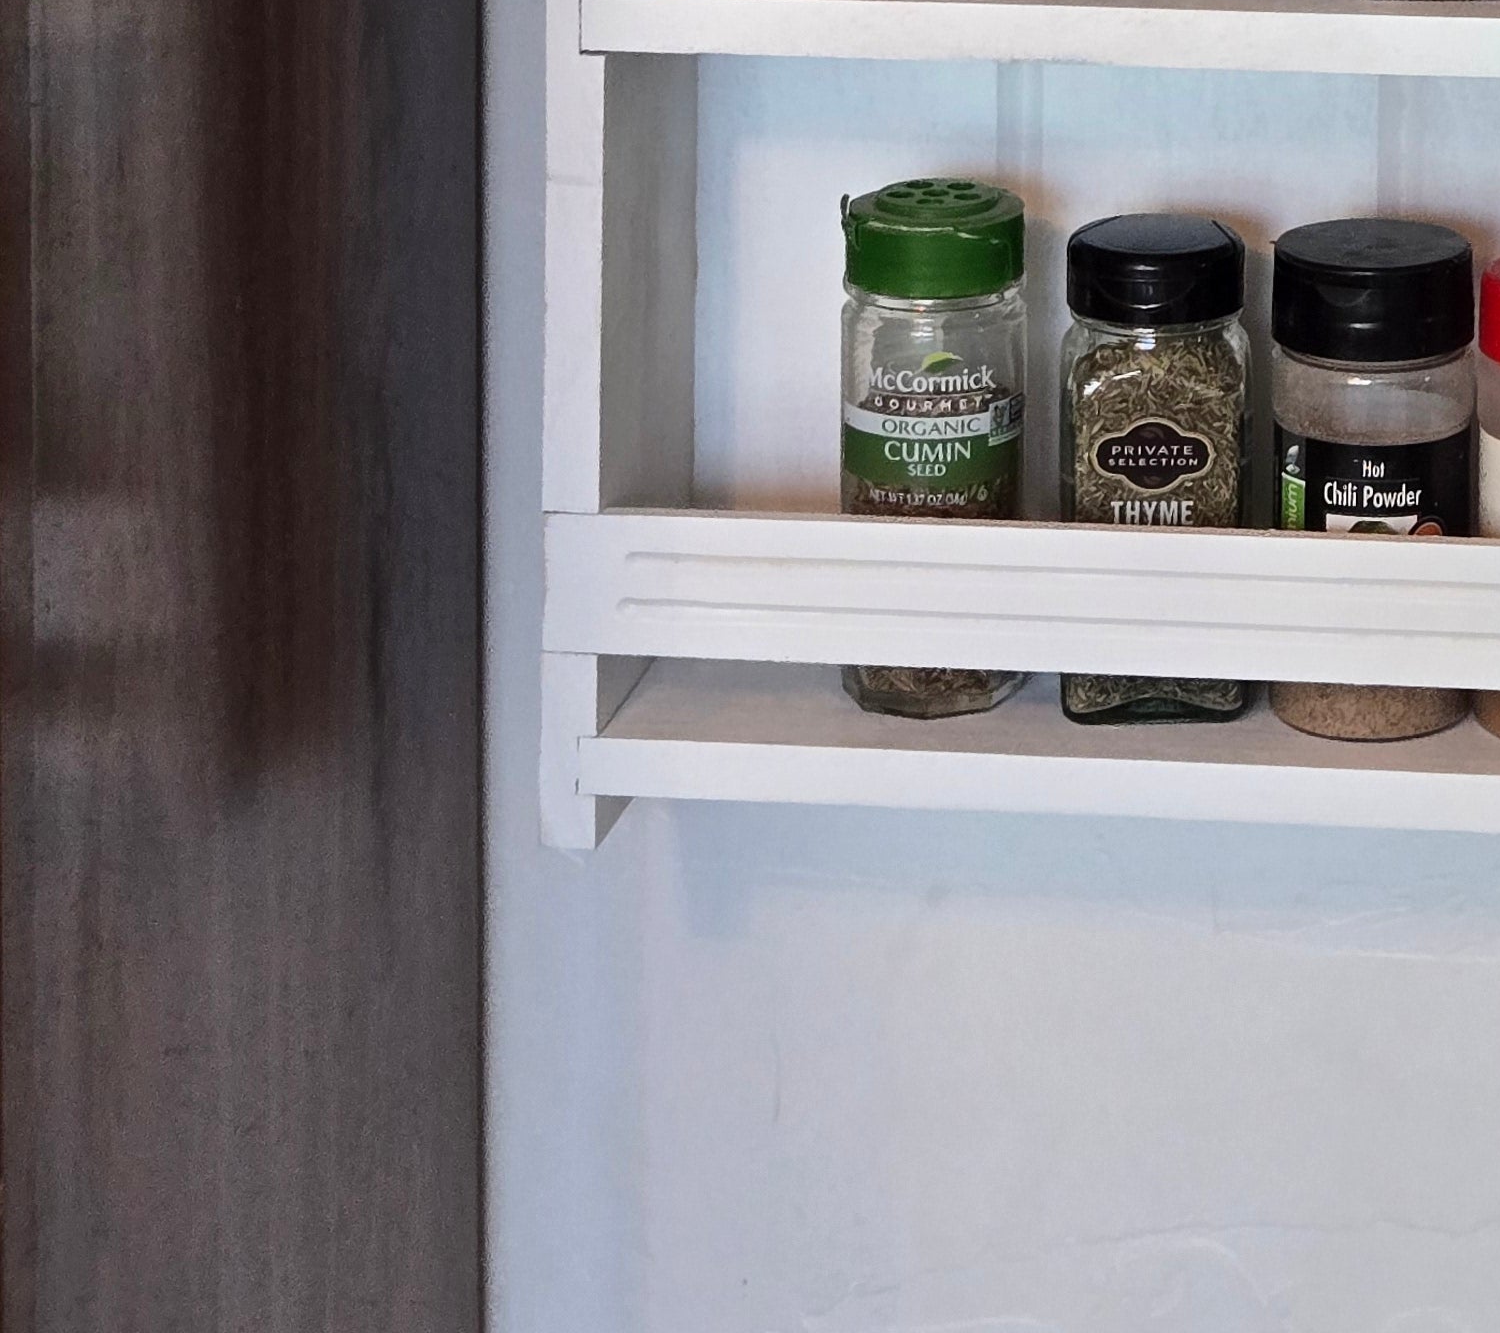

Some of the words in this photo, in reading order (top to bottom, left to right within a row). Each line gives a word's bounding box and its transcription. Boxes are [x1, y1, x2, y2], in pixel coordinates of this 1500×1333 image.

[869, 364, 997, 393] McCormick
[874, 396, 984, 412] GOURMET
[881, 418, 981, 436] ORGANIC
[884, 440, 971, 462] CUMIN
[1112, 445, 1194, 456] PRIVATE
[907, 464, 947, 477] SEED
[1108, 458, 1198, 466] SELECTION
[1362, 460, 1385, 478] Hot
[1324, 481, 1357, 507] Chili
[1363, 484, 1422, 508] Powder
[1110, 500, 1194, 526] THYME
